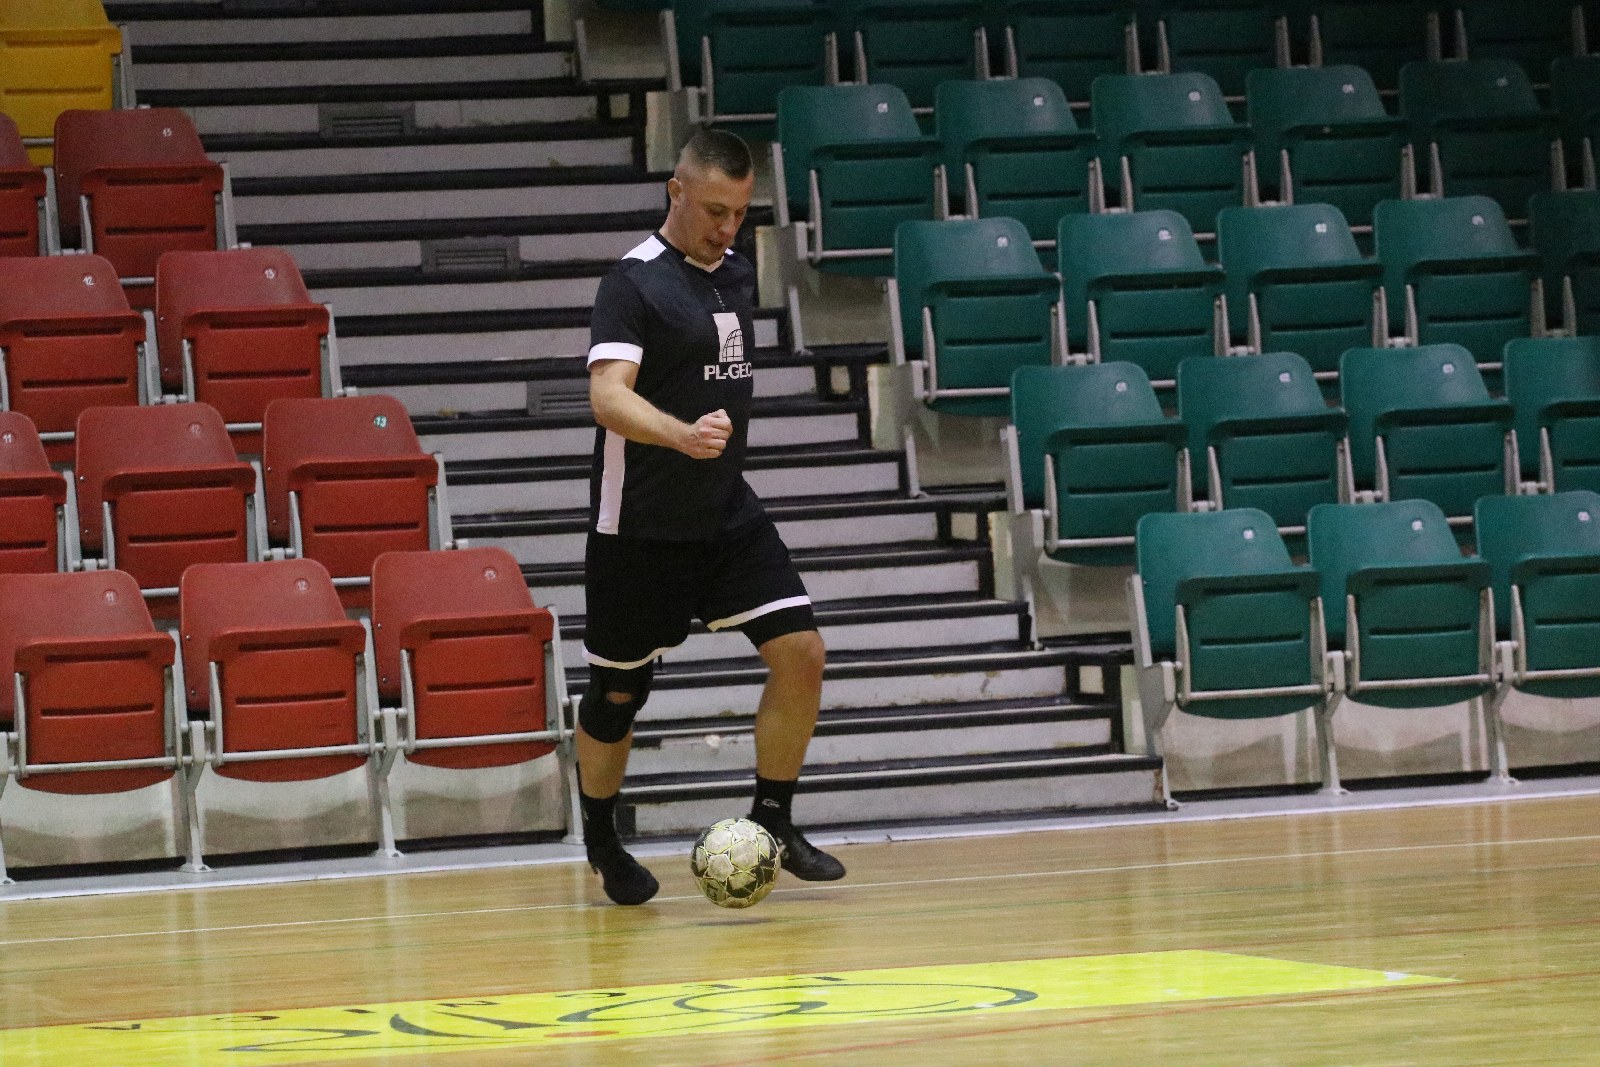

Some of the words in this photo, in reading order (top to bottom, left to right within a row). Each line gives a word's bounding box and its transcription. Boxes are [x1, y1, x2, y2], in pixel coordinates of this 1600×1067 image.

[83, 276, 95, 286] 12
[374, 415, 388, 428] 13
[3, 432, 12, 444] 11
